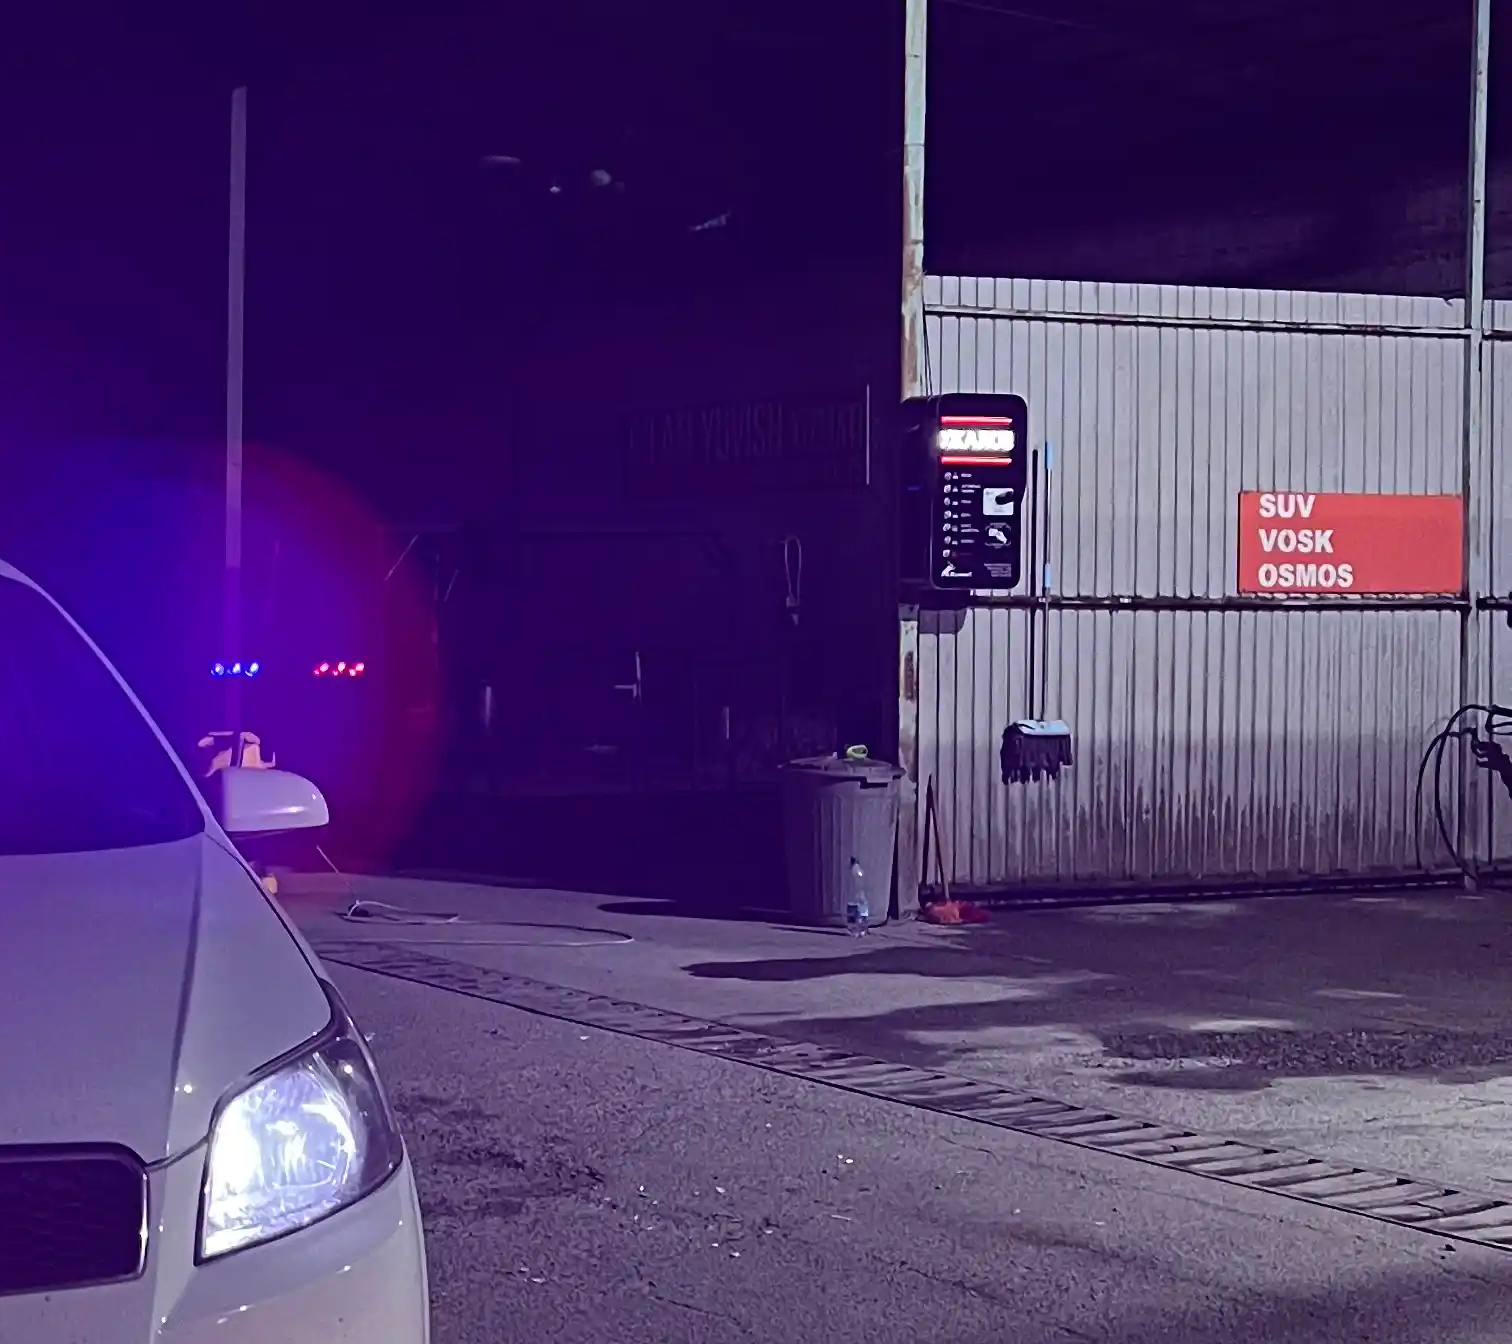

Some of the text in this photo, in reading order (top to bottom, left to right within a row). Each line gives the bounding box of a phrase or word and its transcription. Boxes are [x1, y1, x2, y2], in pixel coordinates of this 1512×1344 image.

[1259, 494, 1315, 518] SUV
[1258, 529, 1334, 553] VOSK
[1258, 563, 1354, 588] OSMOS
